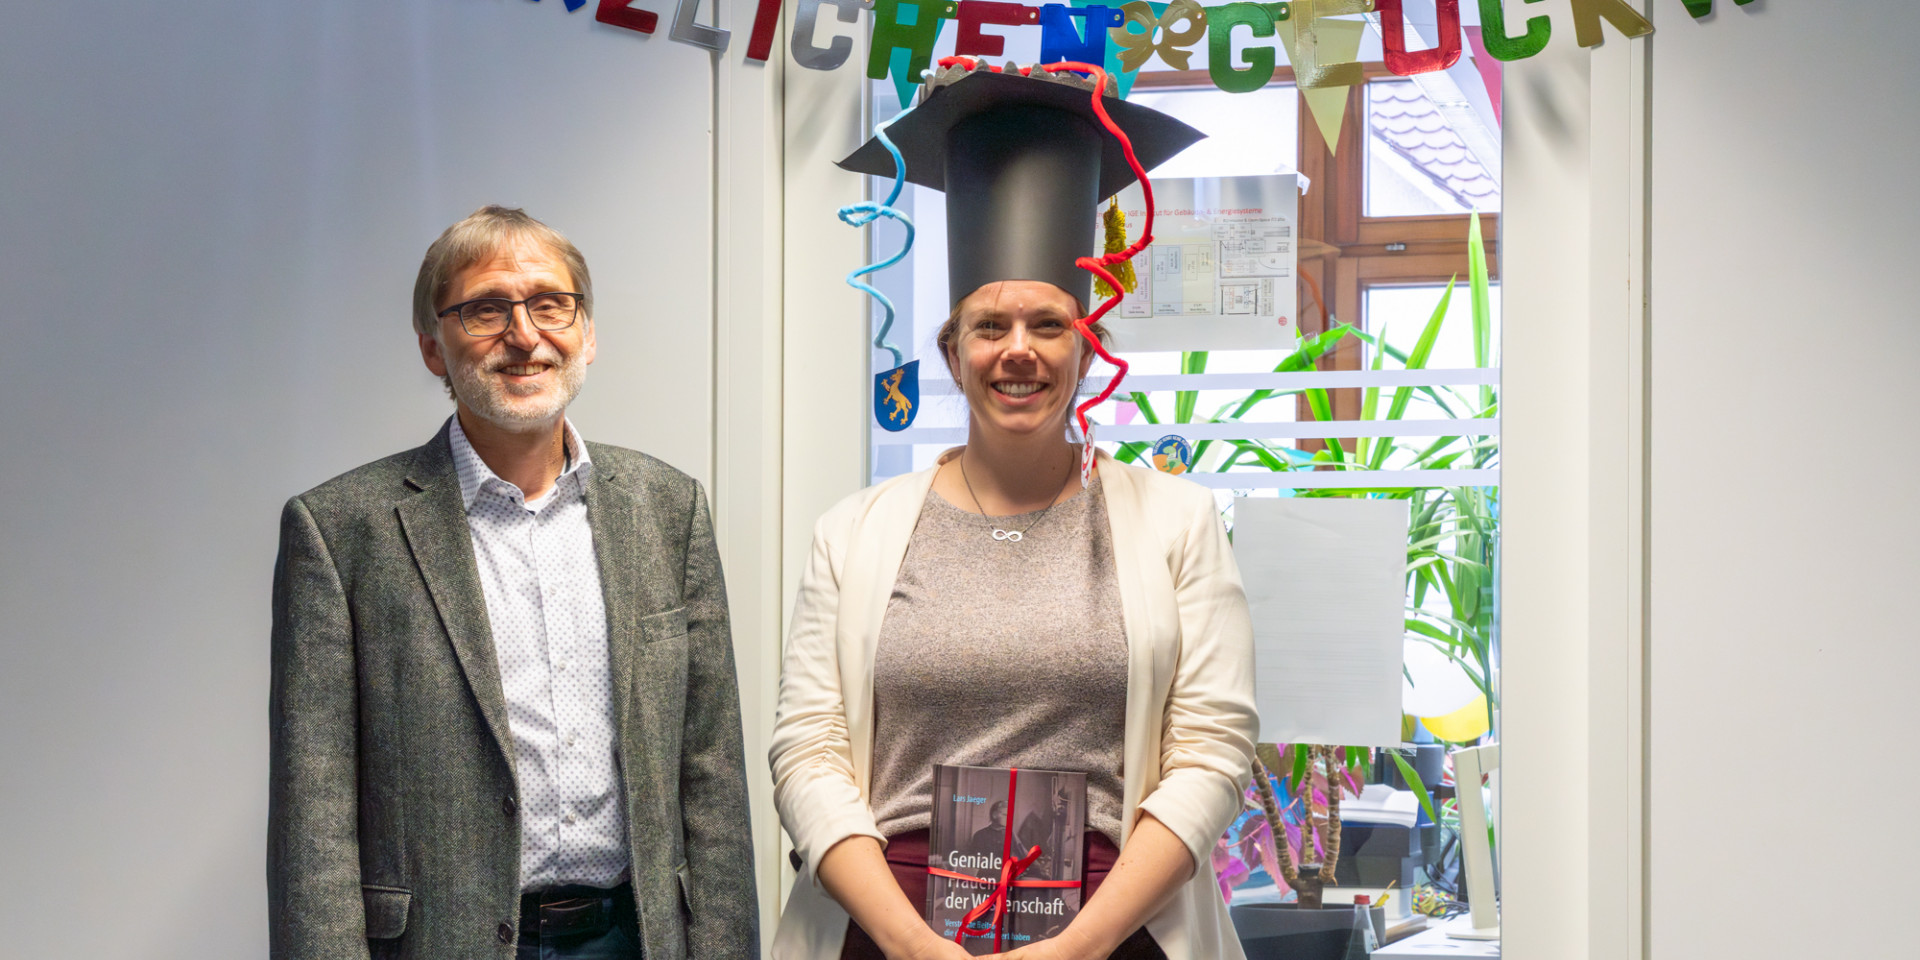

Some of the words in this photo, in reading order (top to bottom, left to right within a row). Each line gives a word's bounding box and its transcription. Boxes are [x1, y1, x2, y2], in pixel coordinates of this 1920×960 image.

[953, 794, 966, 802] Lars
[948, 850, 1002, 870] Geniale
[945, 892, 969, 910] der
